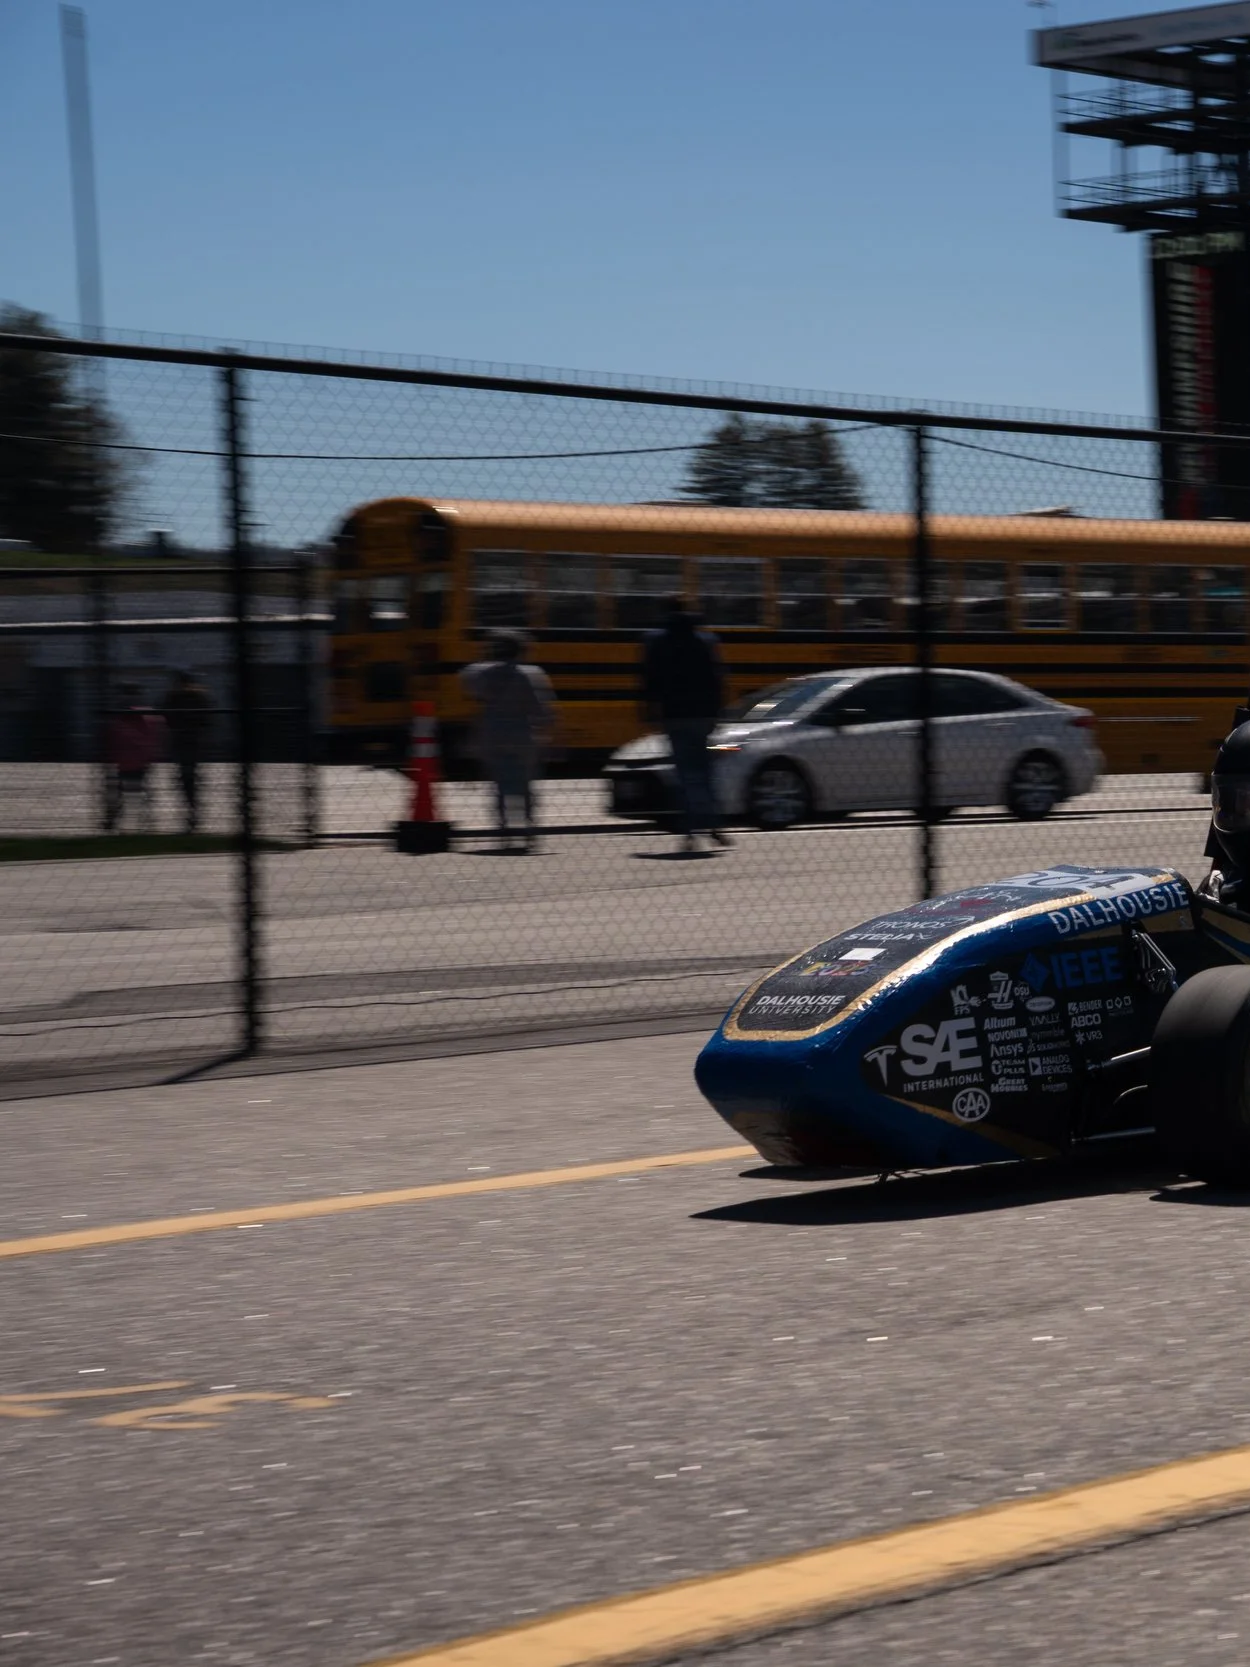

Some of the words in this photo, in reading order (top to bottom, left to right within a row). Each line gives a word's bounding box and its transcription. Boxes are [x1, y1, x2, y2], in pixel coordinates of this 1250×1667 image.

[1048, 883, 1190, 935] DALHOUSIE
[1050, 946, 1124, 990] IEEE
[755, 995, 846, 1006] DALHOUSIE
[747, 1005, 837, 1015] UNIVERSITY
[983, 1016, 1016, 1031] Altium
[1070, 1013, 1102, 1029] ABCO
[1086, 1029, 1103, 1041] VR3
[990, 1042, 1025, 1058] Ansys
[1042, 1054, 1070, 1065] ANALOG
[1042, 1064, 1073, 1075] DEVICES
[903, 1072, 985, 1094] INTERNATIONAL
[957, 1092, 987, 1118] CAA
